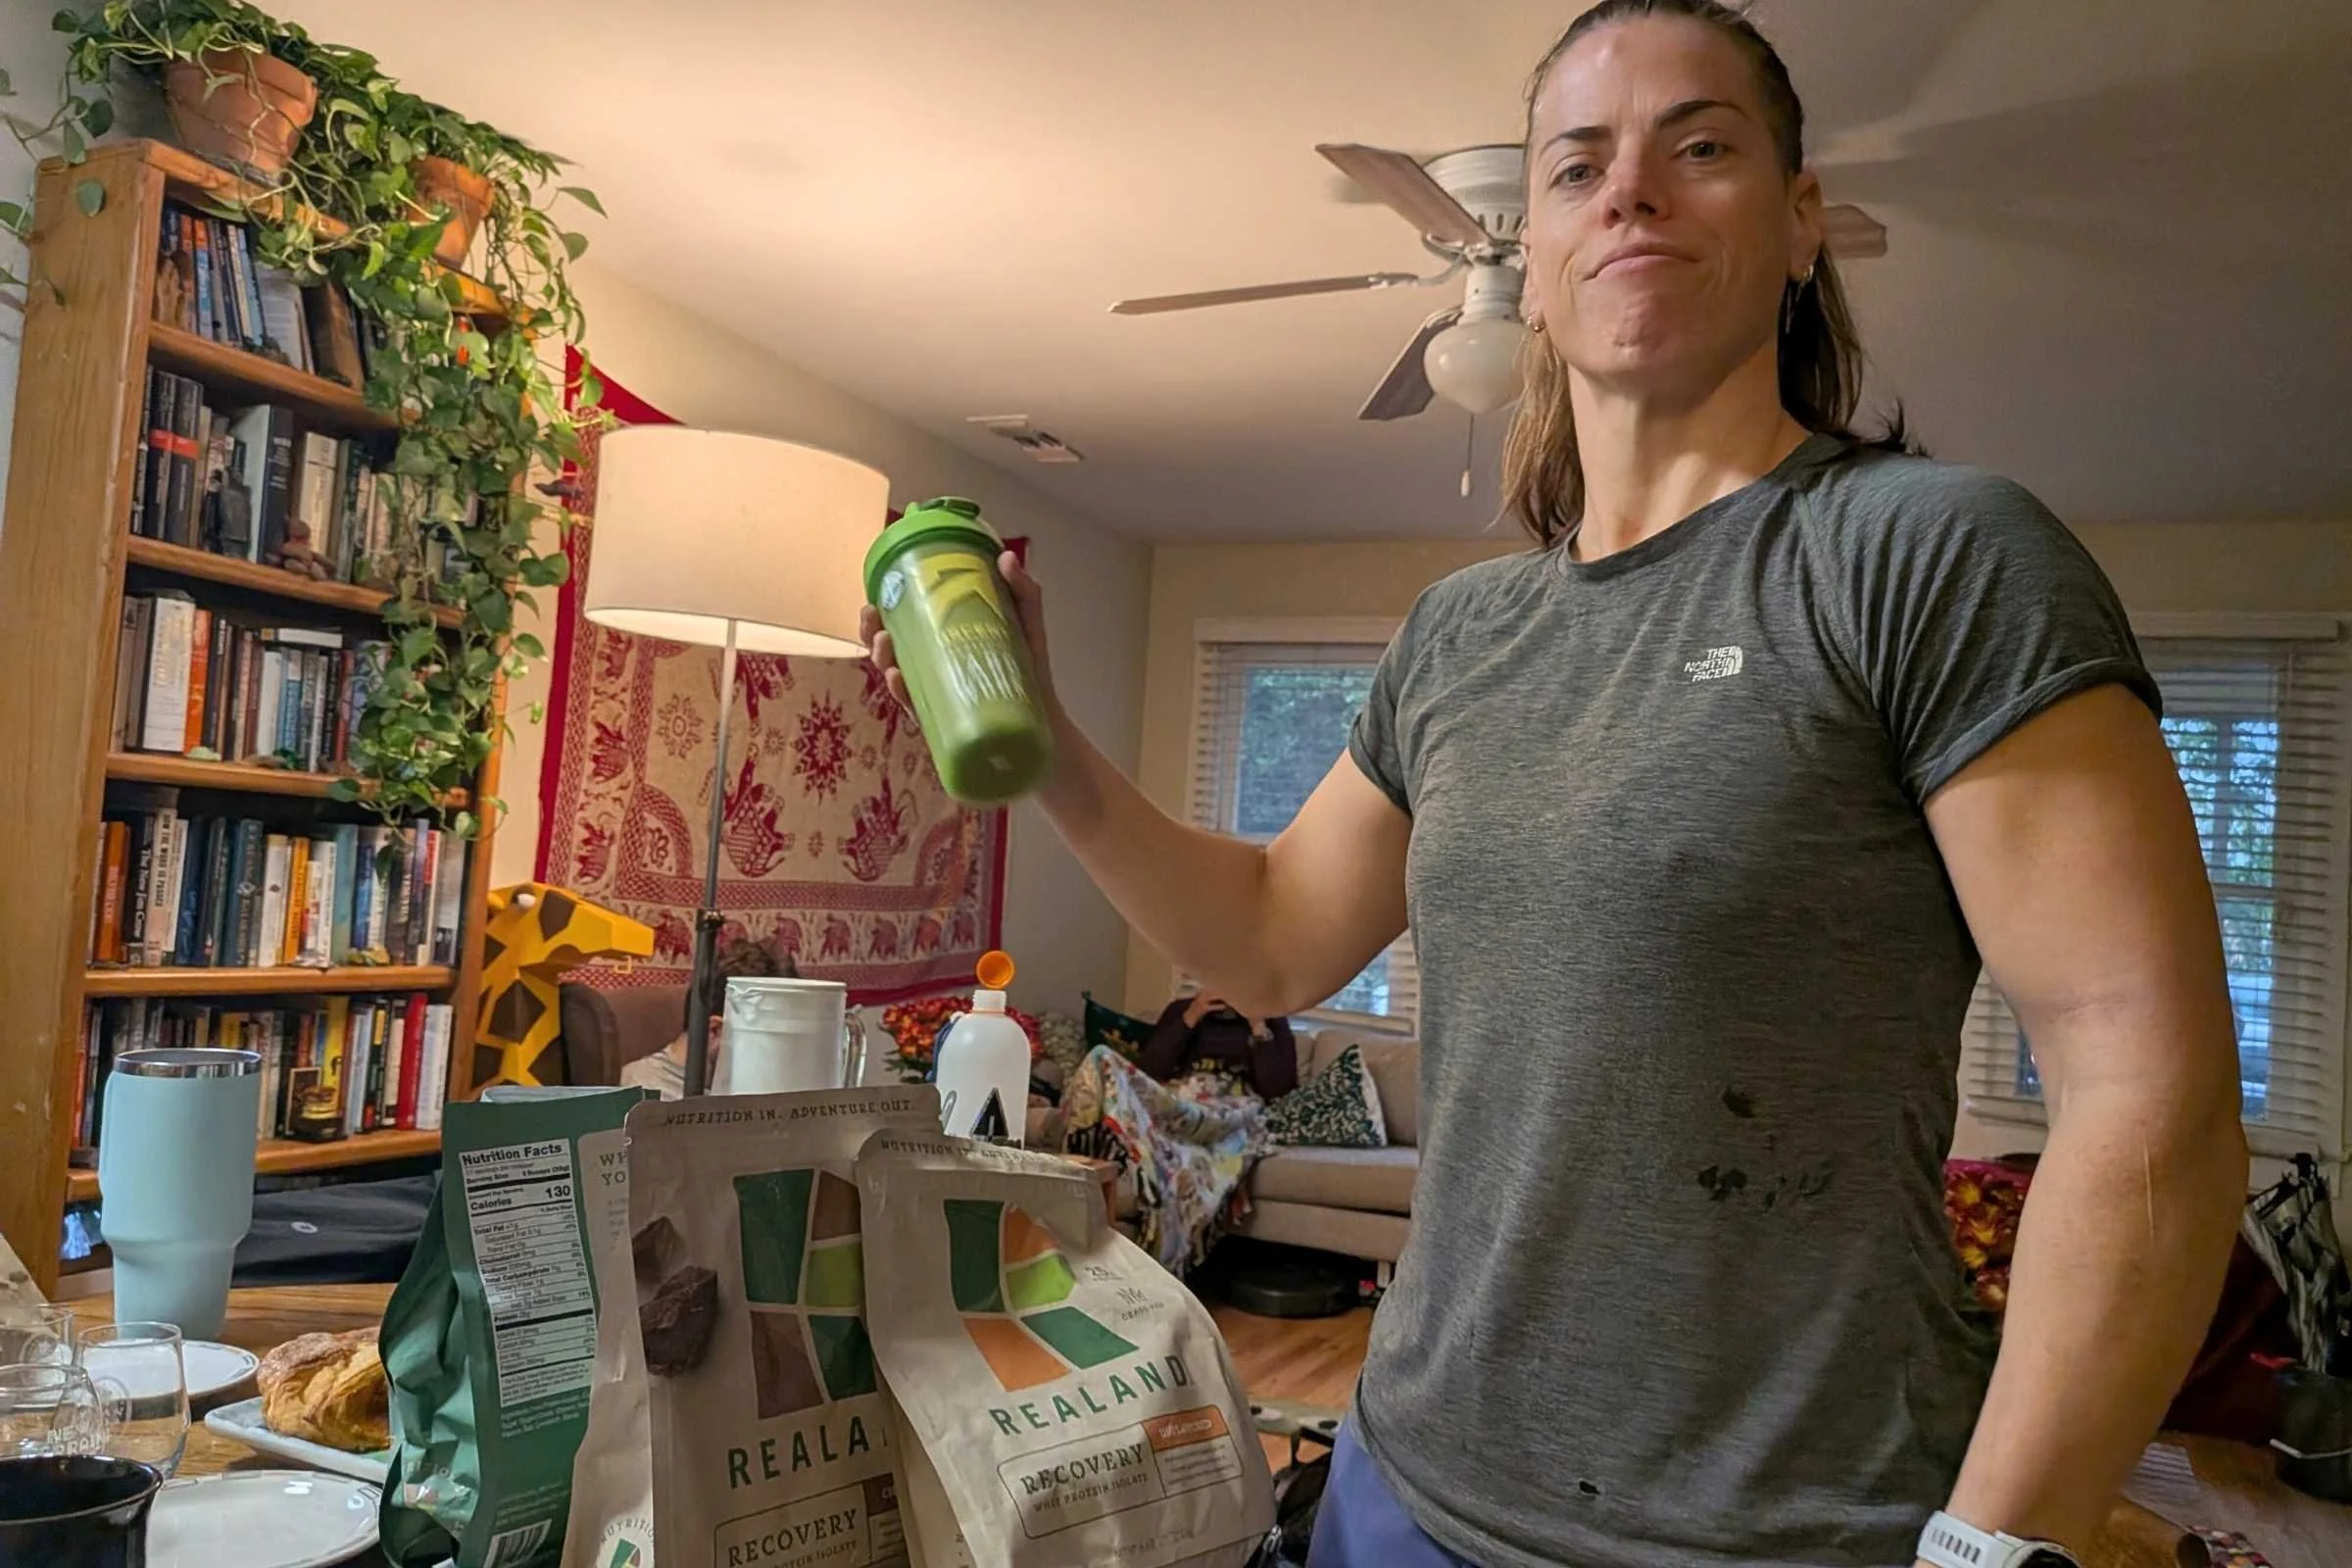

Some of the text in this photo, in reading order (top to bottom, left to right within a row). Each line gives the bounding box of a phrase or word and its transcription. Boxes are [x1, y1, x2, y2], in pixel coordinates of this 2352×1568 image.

[1684, 658, 1726, 673] NORTH
[1707, 647, 1730, 660] THE
[1691, 668, 1724, 683] FACE
[140, 848, 152, 867] The
[137, 869, 150, 892] New
[133, 911, 146, 939] Crow
[664, 1110, 754, 1125] NUTRITION
[790, 1102, 877, 1119] ADVENTURE
[462, 1144, 563, 1166] Nutrition Facts
[881, 1139, 953, 1155] NUTRITION
[470, 1185, 571, 1211] Calories 130
[988, 1354, 1189, 1436] REALAND
[727, 1416, 888, 1490] REALA
[1019, 1444, 1146, 1495] RECOVERY
[1064, 1484, 1109, 1505] PROTEIN
[1111, 1473, 1149, 1490] ISOLATE
[601, 1518, 654, 1546] NUTRITIO
[727, 1508, 858, 1568] RECOVERY
